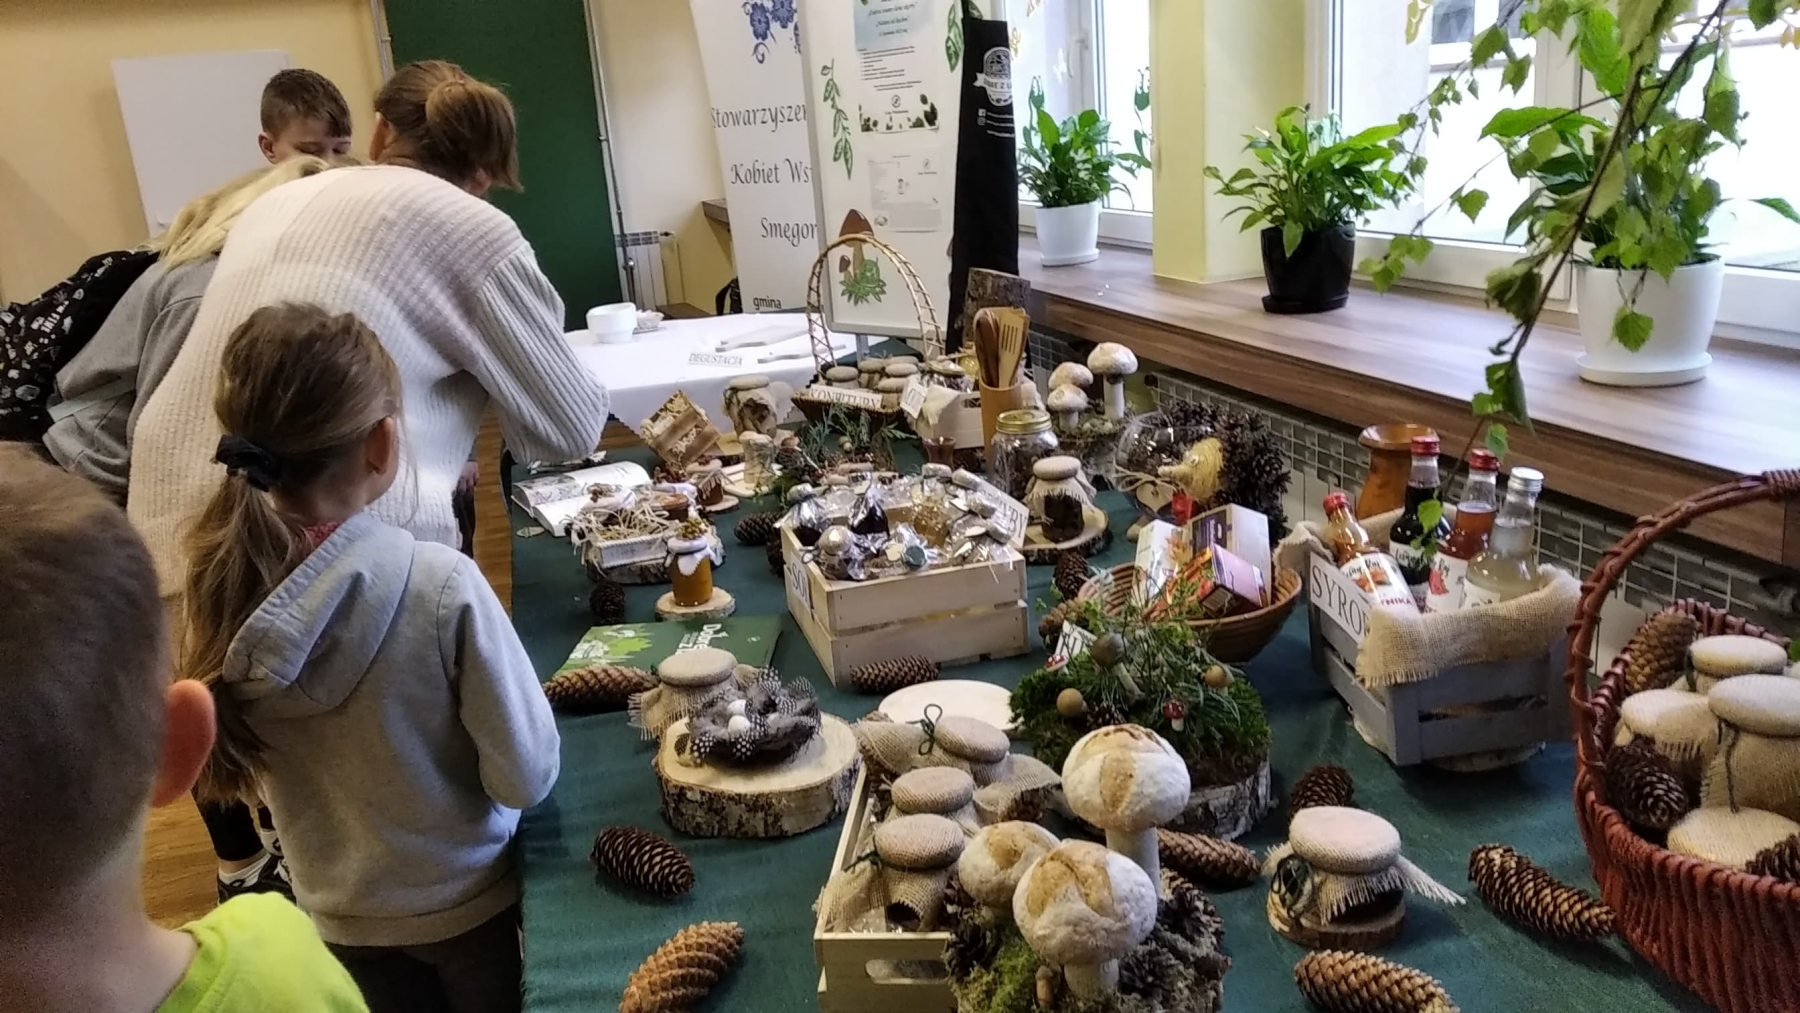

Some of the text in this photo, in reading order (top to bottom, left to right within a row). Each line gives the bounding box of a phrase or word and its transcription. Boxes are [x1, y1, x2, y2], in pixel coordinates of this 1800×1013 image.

[731, 158, 813, 184] Kobiet Ws
[753, 296, 781, 311] gmina
